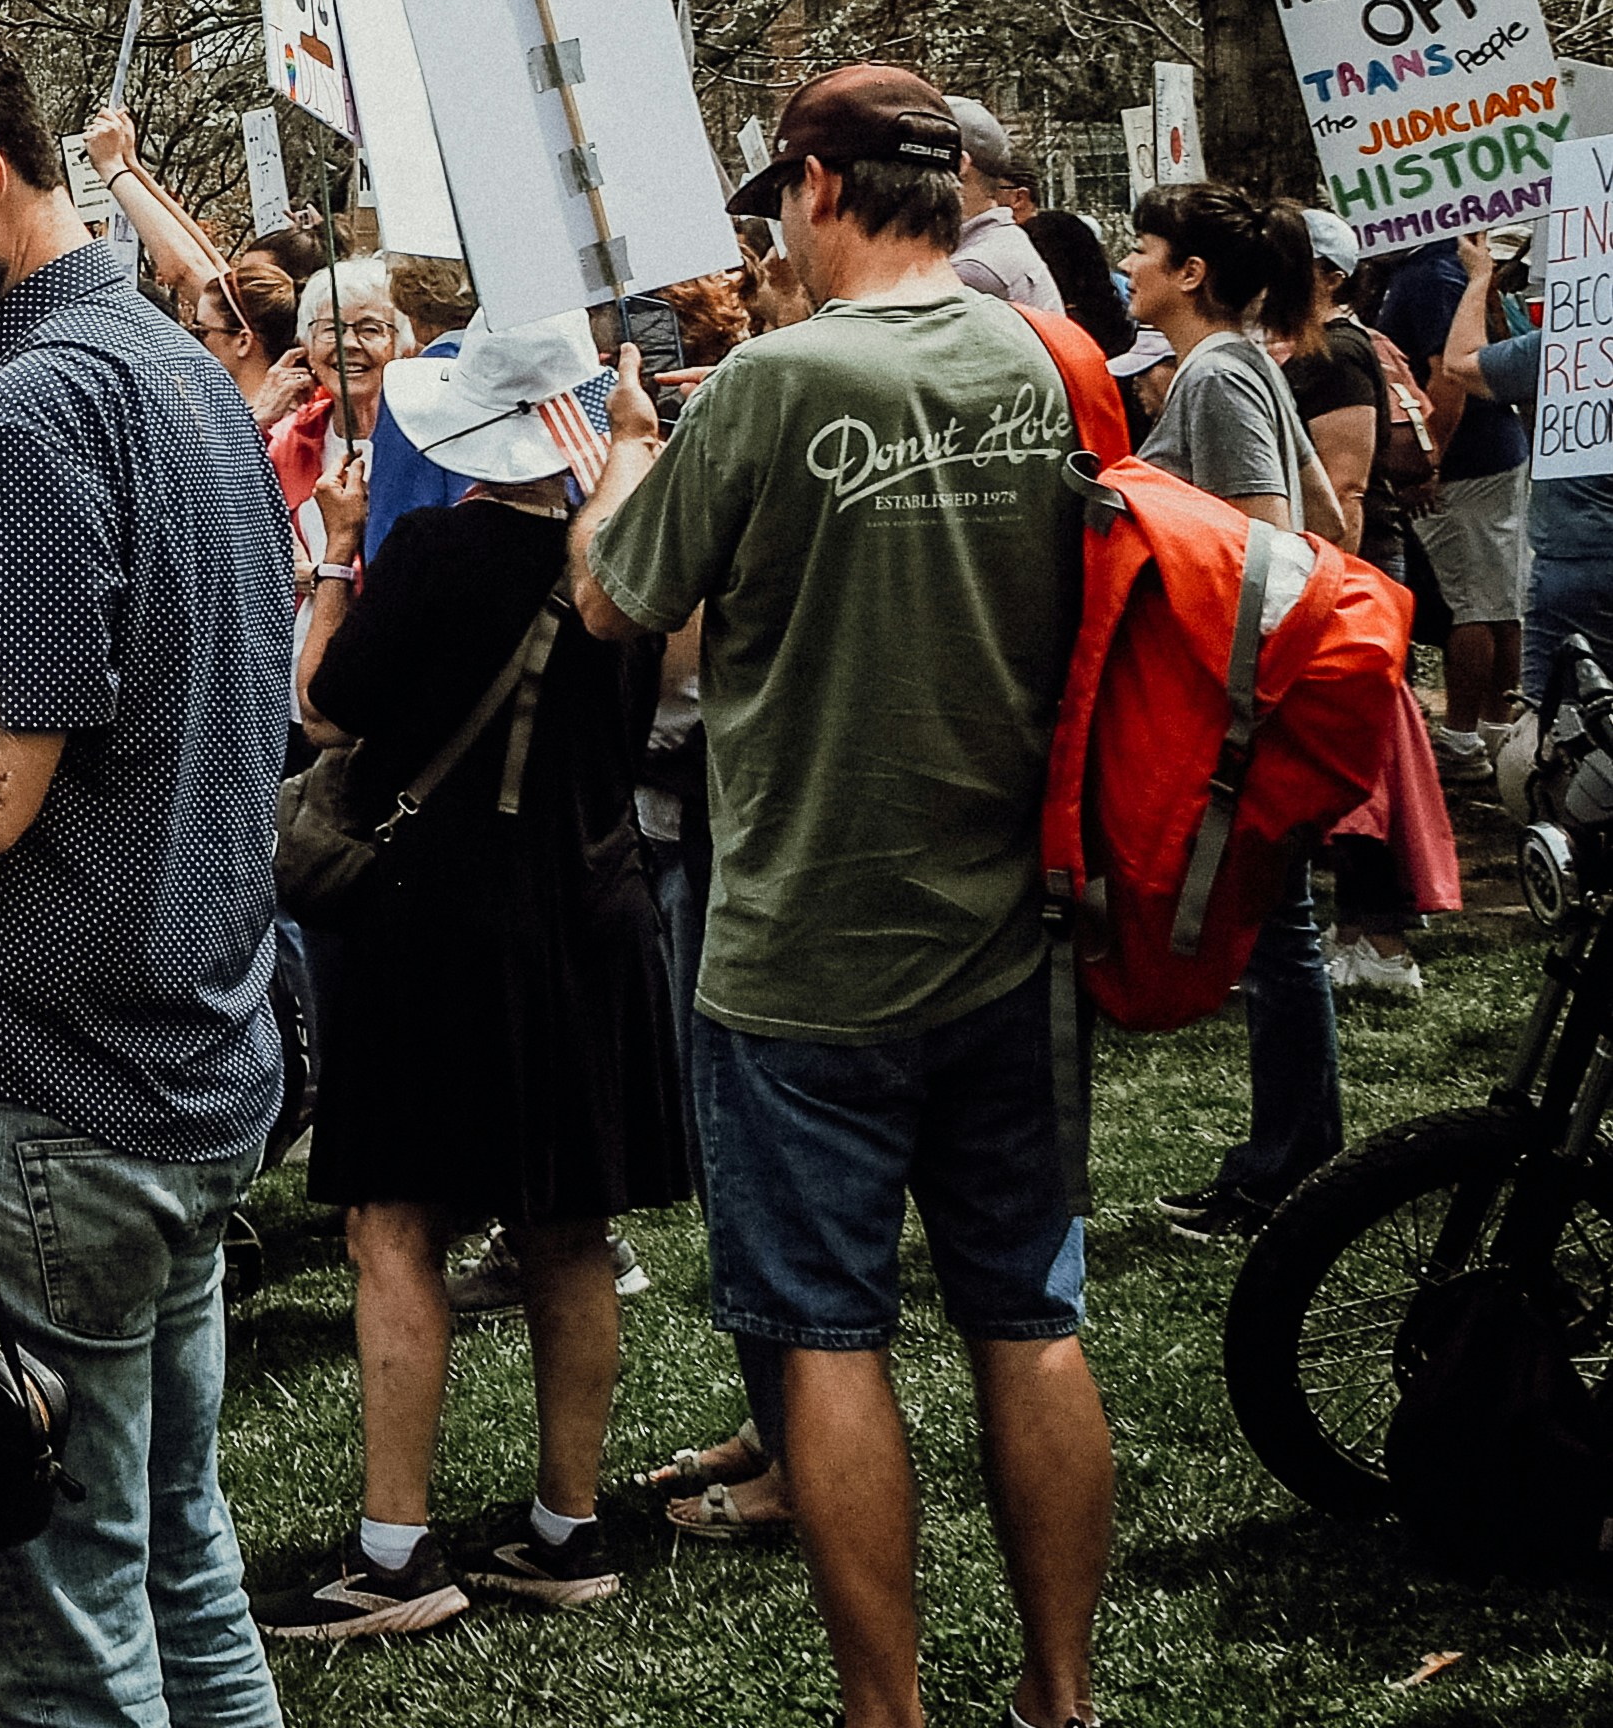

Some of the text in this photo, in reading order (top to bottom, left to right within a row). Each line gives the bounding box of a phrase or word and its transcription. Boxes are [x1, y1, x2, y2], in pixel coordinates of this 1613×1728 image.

[1302, 21, 1530, 103] TRANS People
[1311, 76, 1558, 155] The JUDICIARY
[1328, 112, 1571, 218] HISTORY
[1547, 201, 1613, 264] IN
[1550, 272, 1613, 333] BEC
[806, 382, 1073, 497] Donut Hole
[875, 490, 1018, 511] ESTABLISHED 1978
